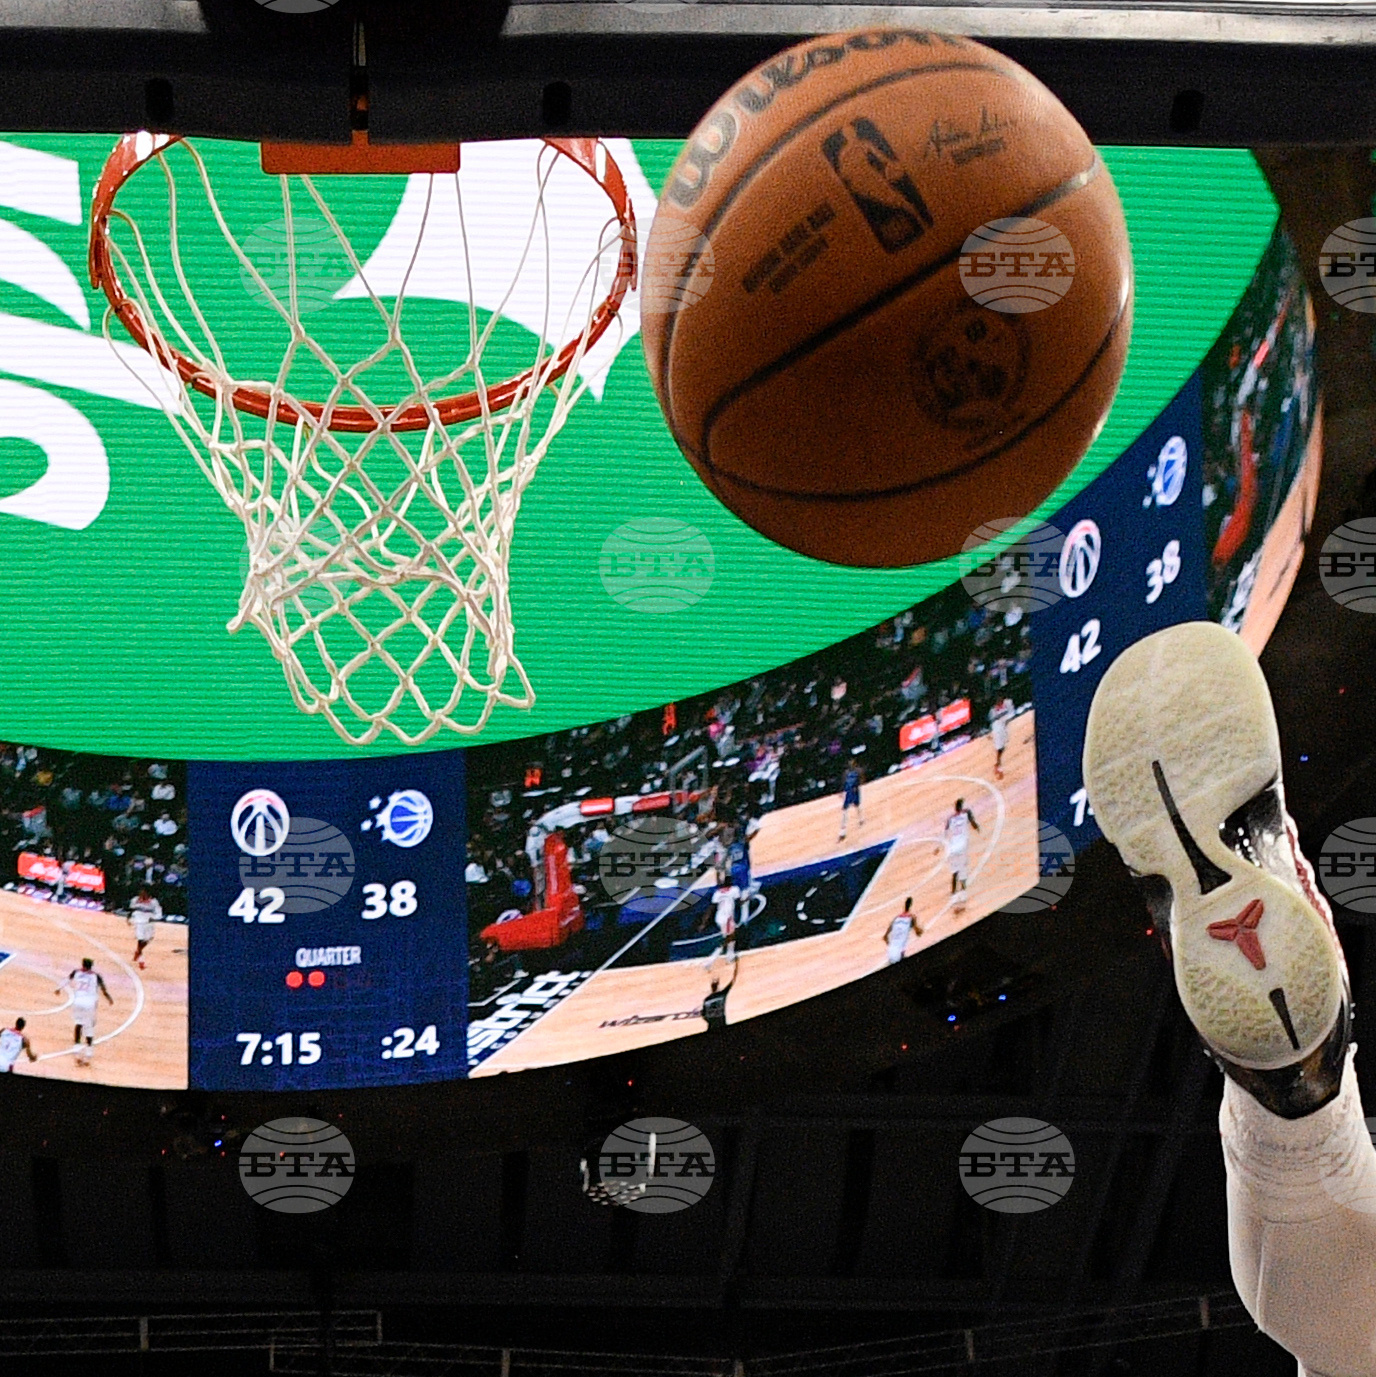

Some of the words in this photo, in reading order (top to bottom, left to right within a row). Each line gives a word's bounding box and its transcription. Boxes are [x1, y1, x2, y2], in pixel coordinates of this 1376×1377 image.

[1059, 618, 1102, 673] 42
[228, 887, 286, 923] 42
[361, 880, 418, 919] 38
[295, 946, 362, 968] QUARTER
[236, 1032, 322, 1065] 7:15
